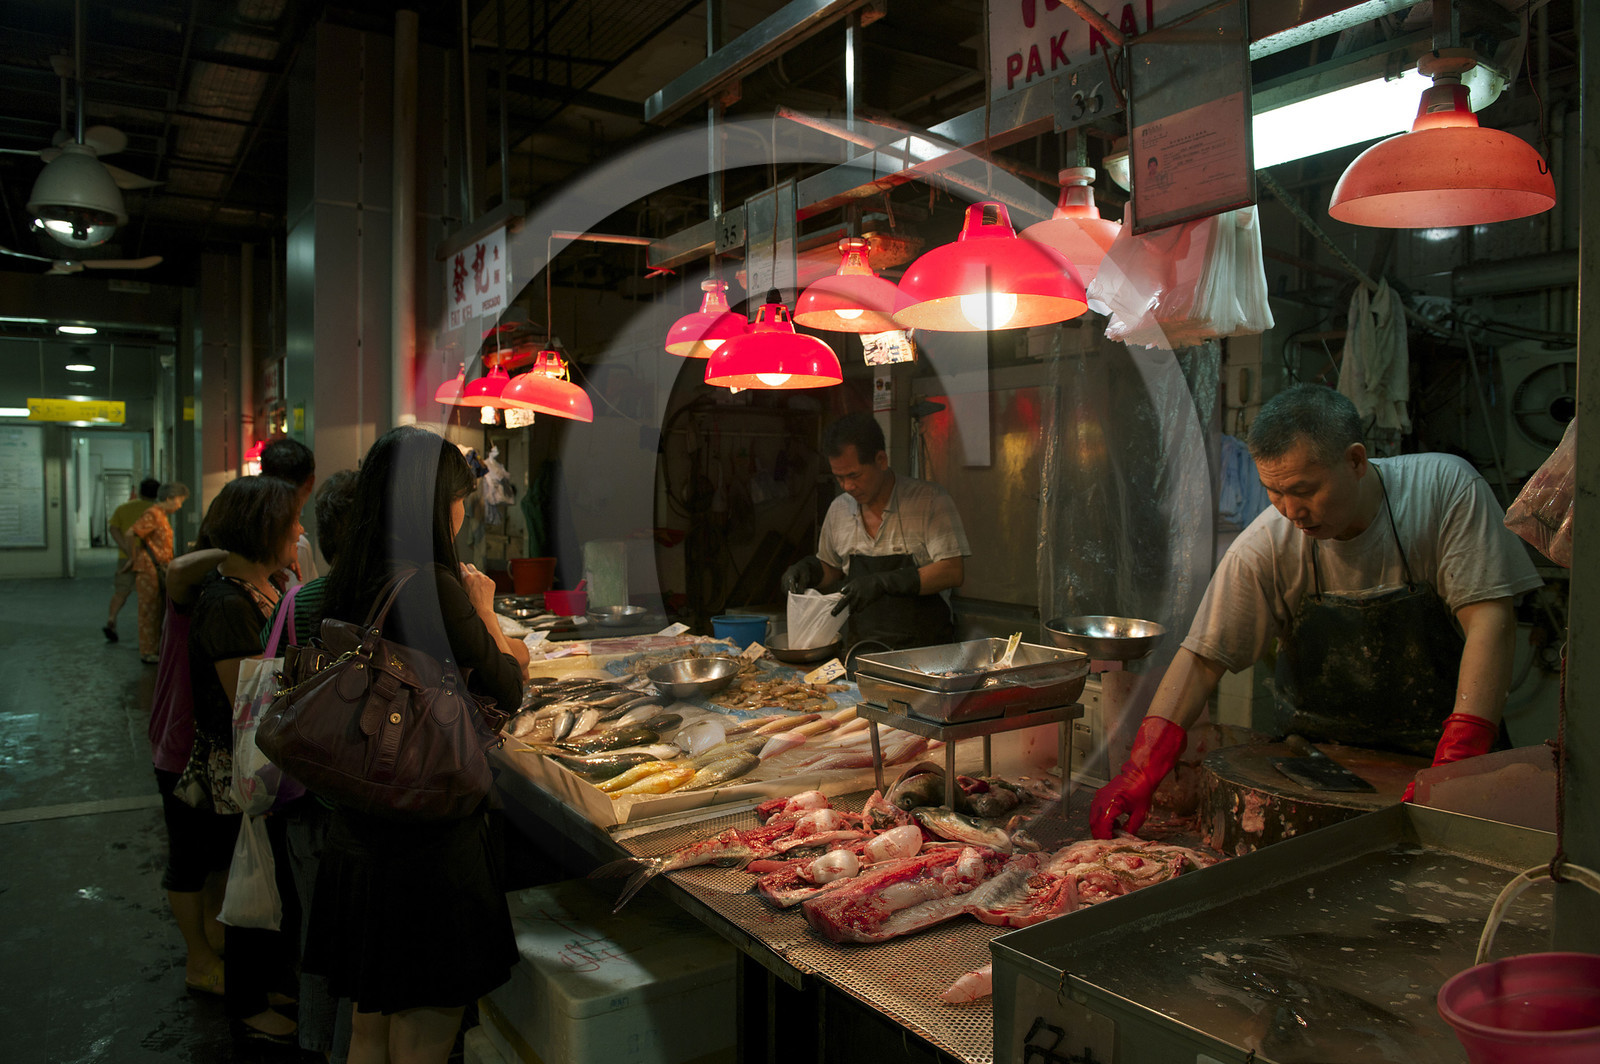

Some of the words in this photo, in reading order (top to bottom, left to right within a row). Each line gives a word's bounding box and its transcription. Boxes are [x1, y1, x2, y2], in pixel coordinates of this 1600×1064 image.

[1006, 29, 1071, 90] PAK
[1089, 0, 1153, 56] KAI
[1071, 80, 1104, 121] 36
[722, 224, 737, 248] 35
